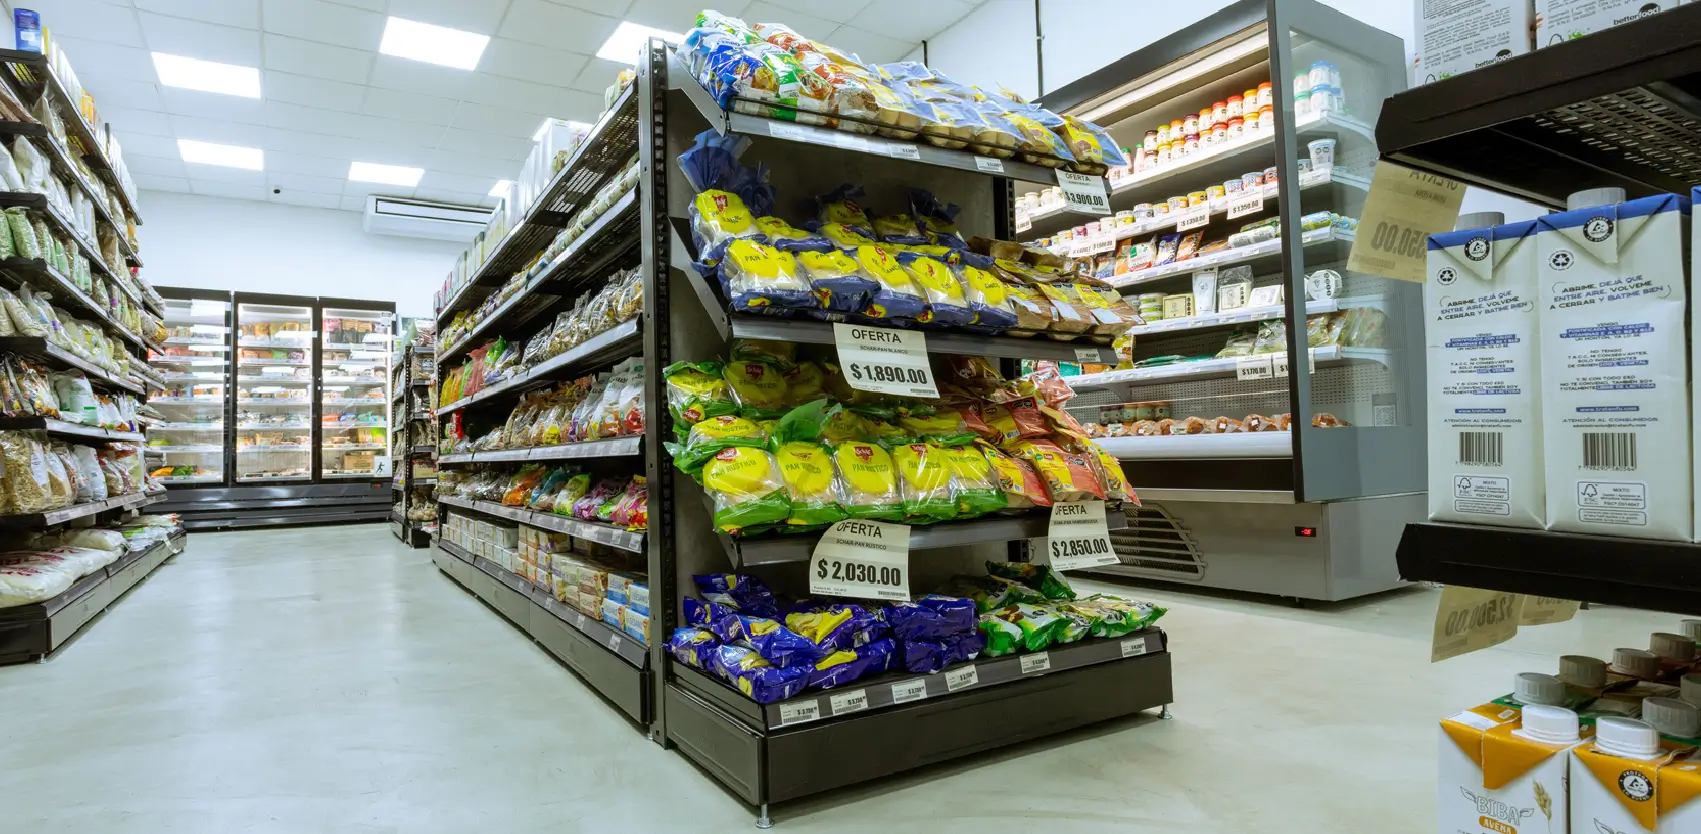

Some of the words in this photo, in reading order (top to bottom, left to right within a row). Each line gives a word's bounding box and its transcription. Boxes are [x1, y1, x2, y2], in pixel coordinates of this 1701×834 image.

[1065, 172, 1091, 182] OFERTA
[1626, 275, 1643, 284] QUE
[1499, 290, 1512, 298] QUE
[1554, 293, 1582, 302] ENTRE
[1610, 281, 1652, 292] VOLVEME
[1559, 299, 1596, 308] CERRAR
[1608, 291, 1640, 301] BATIME
[1643, 286, 1664, 295] BIEN
[1486, 296, 1519, 307] VOLVEME
[1445, 312, 1475, 320] CERRAR
[852, 328, 902, 343] OFERTA
[850, 363, 862, 380] $
[864, 365, 928, 384] 1,890.00
[836, 522, 882, 538] OFERTA
[1052, 540, 1060, 558] $
[1061, 538, 1109, 557] 2,850.00
[817, 558, 828, 580] $
[832, 561, 901, 586] 2,030.00
[1477, 796, 1520, 826] BIBA
[1483, 819, 1511, 834] AVENA
